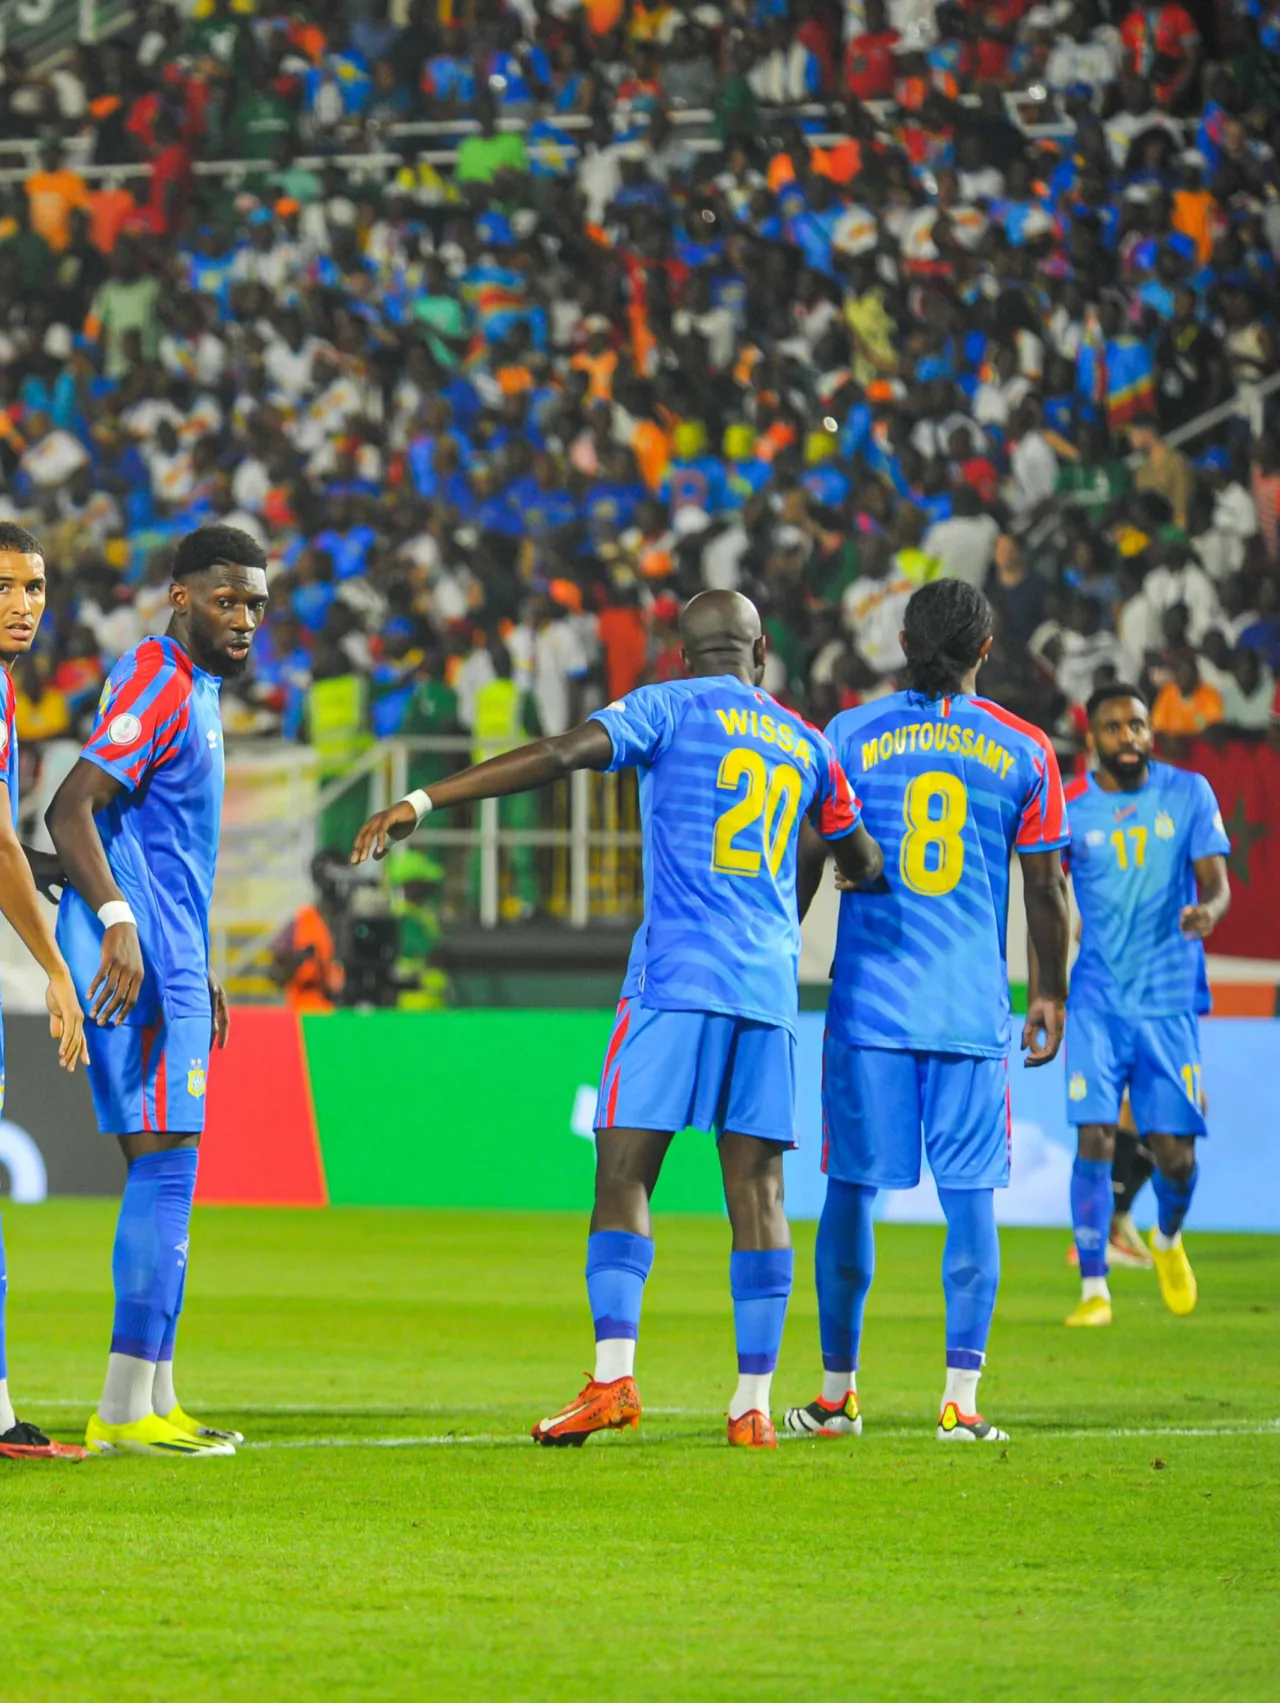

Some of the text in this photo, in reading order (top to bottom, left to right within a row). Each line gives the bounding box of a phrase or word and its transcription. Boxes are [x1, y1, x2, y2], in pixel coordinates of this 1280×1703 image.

[716, 708, 810, 768] WISSA
[862, 722, 1015, 780] MOUTOUSSAMY
[711, 747, 803, 878] 20
[899, 770, 968, 897] 8
[1111, 825, 1148, 870] 17
